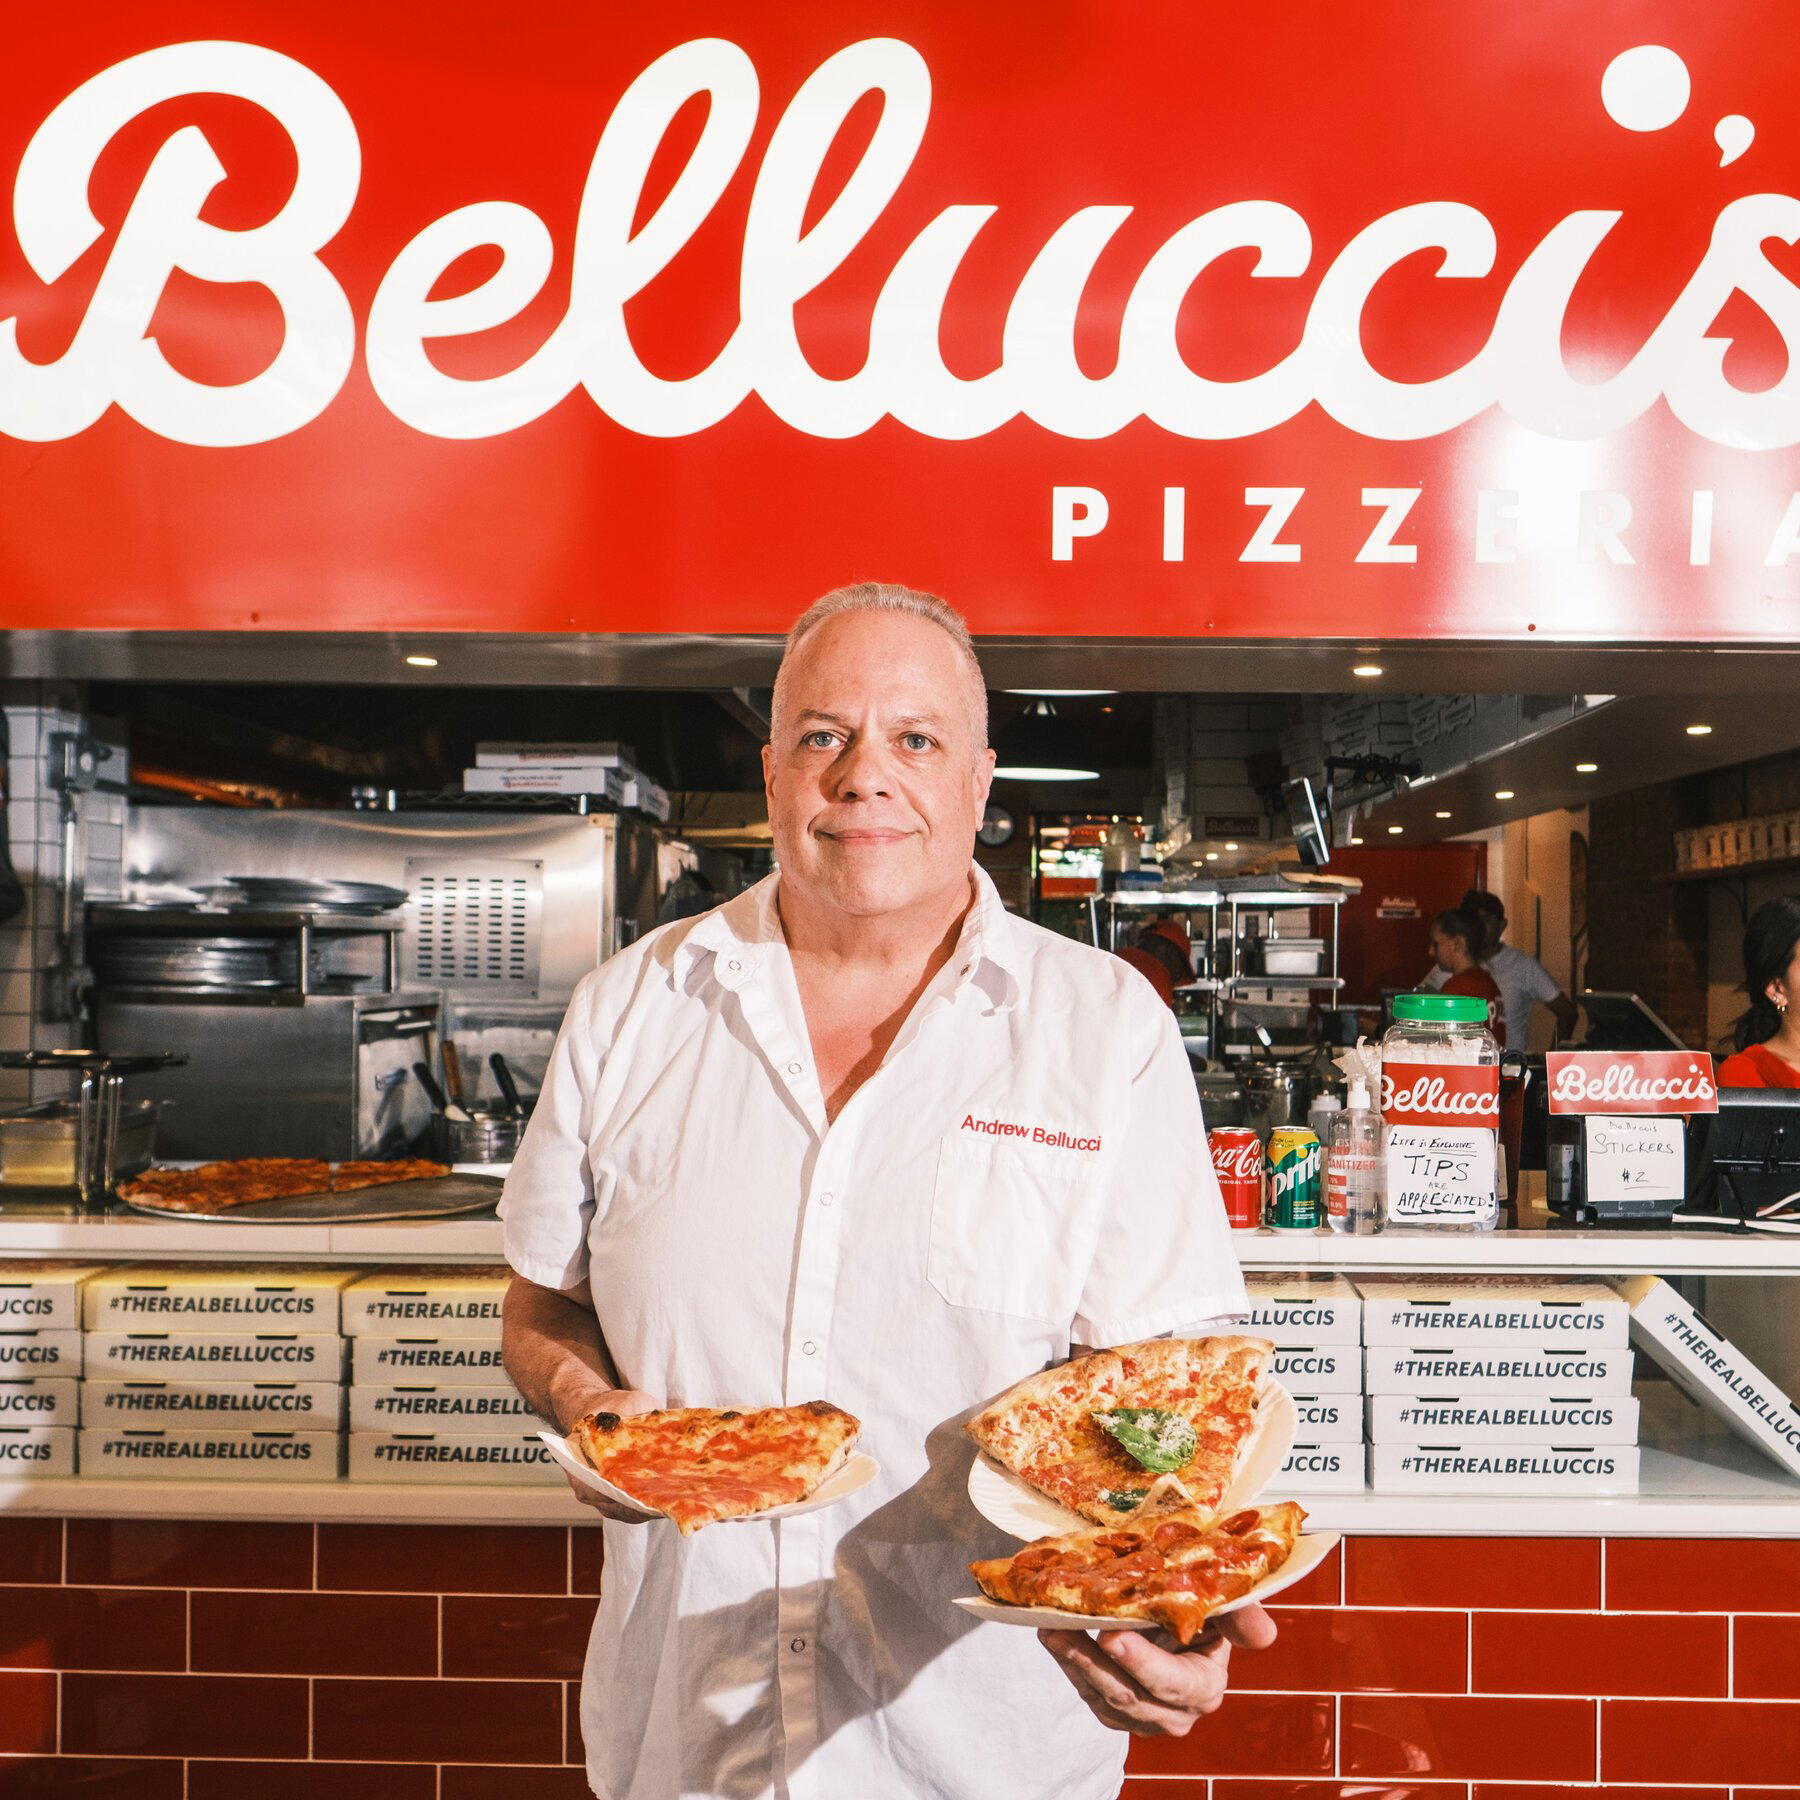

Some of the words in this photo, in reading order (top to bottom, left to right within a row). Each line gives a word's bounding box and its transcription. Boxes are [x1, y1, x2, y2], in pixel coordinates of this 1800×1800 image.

[0, 38, 1800, 450] Bellucci's
[1552, 1064, 1714, 1103] Bellucci's
[961, 1115, 1030, 1138] Andrew
[1033, 1127, 1101, 1151] Bellucci
[1590, 1133, 1674, 1154] STICKERS
[1404, 1155, 1469, 1181] TIPS
[110, 1297, 315, 1313] #THEREALBELLUCCIS
[1391, 1312, 1605, 1329] #THEREALBELLUCCIS
[108, 1346, 315, 1362] #THEREALBELLUCCIS
[1394, 1361, 1607, 1378] #THEREALBELLUCCIS
[1664, 1313, 1800, 1454] #THEREALBELLUC
[104, 1394, 312, 1411] #THEREALBELLUCCIS
[1400, 1409, 1613, 1425] #THEREALBELLUCCIS
[102, 1441, 311, 1460] #THEREALBELLUCCIS
[374, 1445, 558, 1464] #THEREALBELLUC
[1401, 1457, 1615, 1474] #THEREALBELLUCCIS
